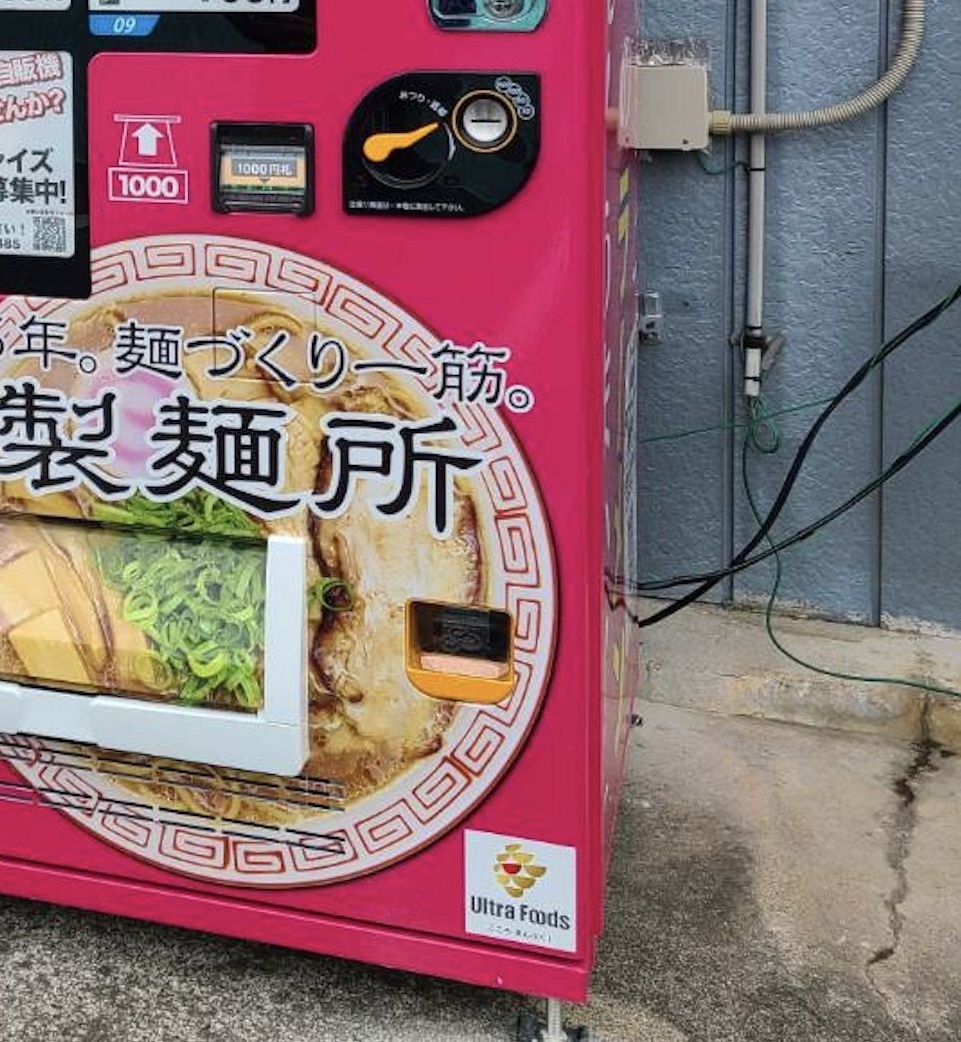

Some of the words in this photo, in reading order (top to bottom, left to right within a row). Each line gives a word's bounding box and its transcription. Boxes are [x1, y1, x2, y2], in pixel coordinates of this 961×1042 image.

[113, 17, 136, 33] 09
[118, 173, 180, 199] 1000
[471, 895, 515, 920] Ultra
[520, 904, 571, 930] Foods
